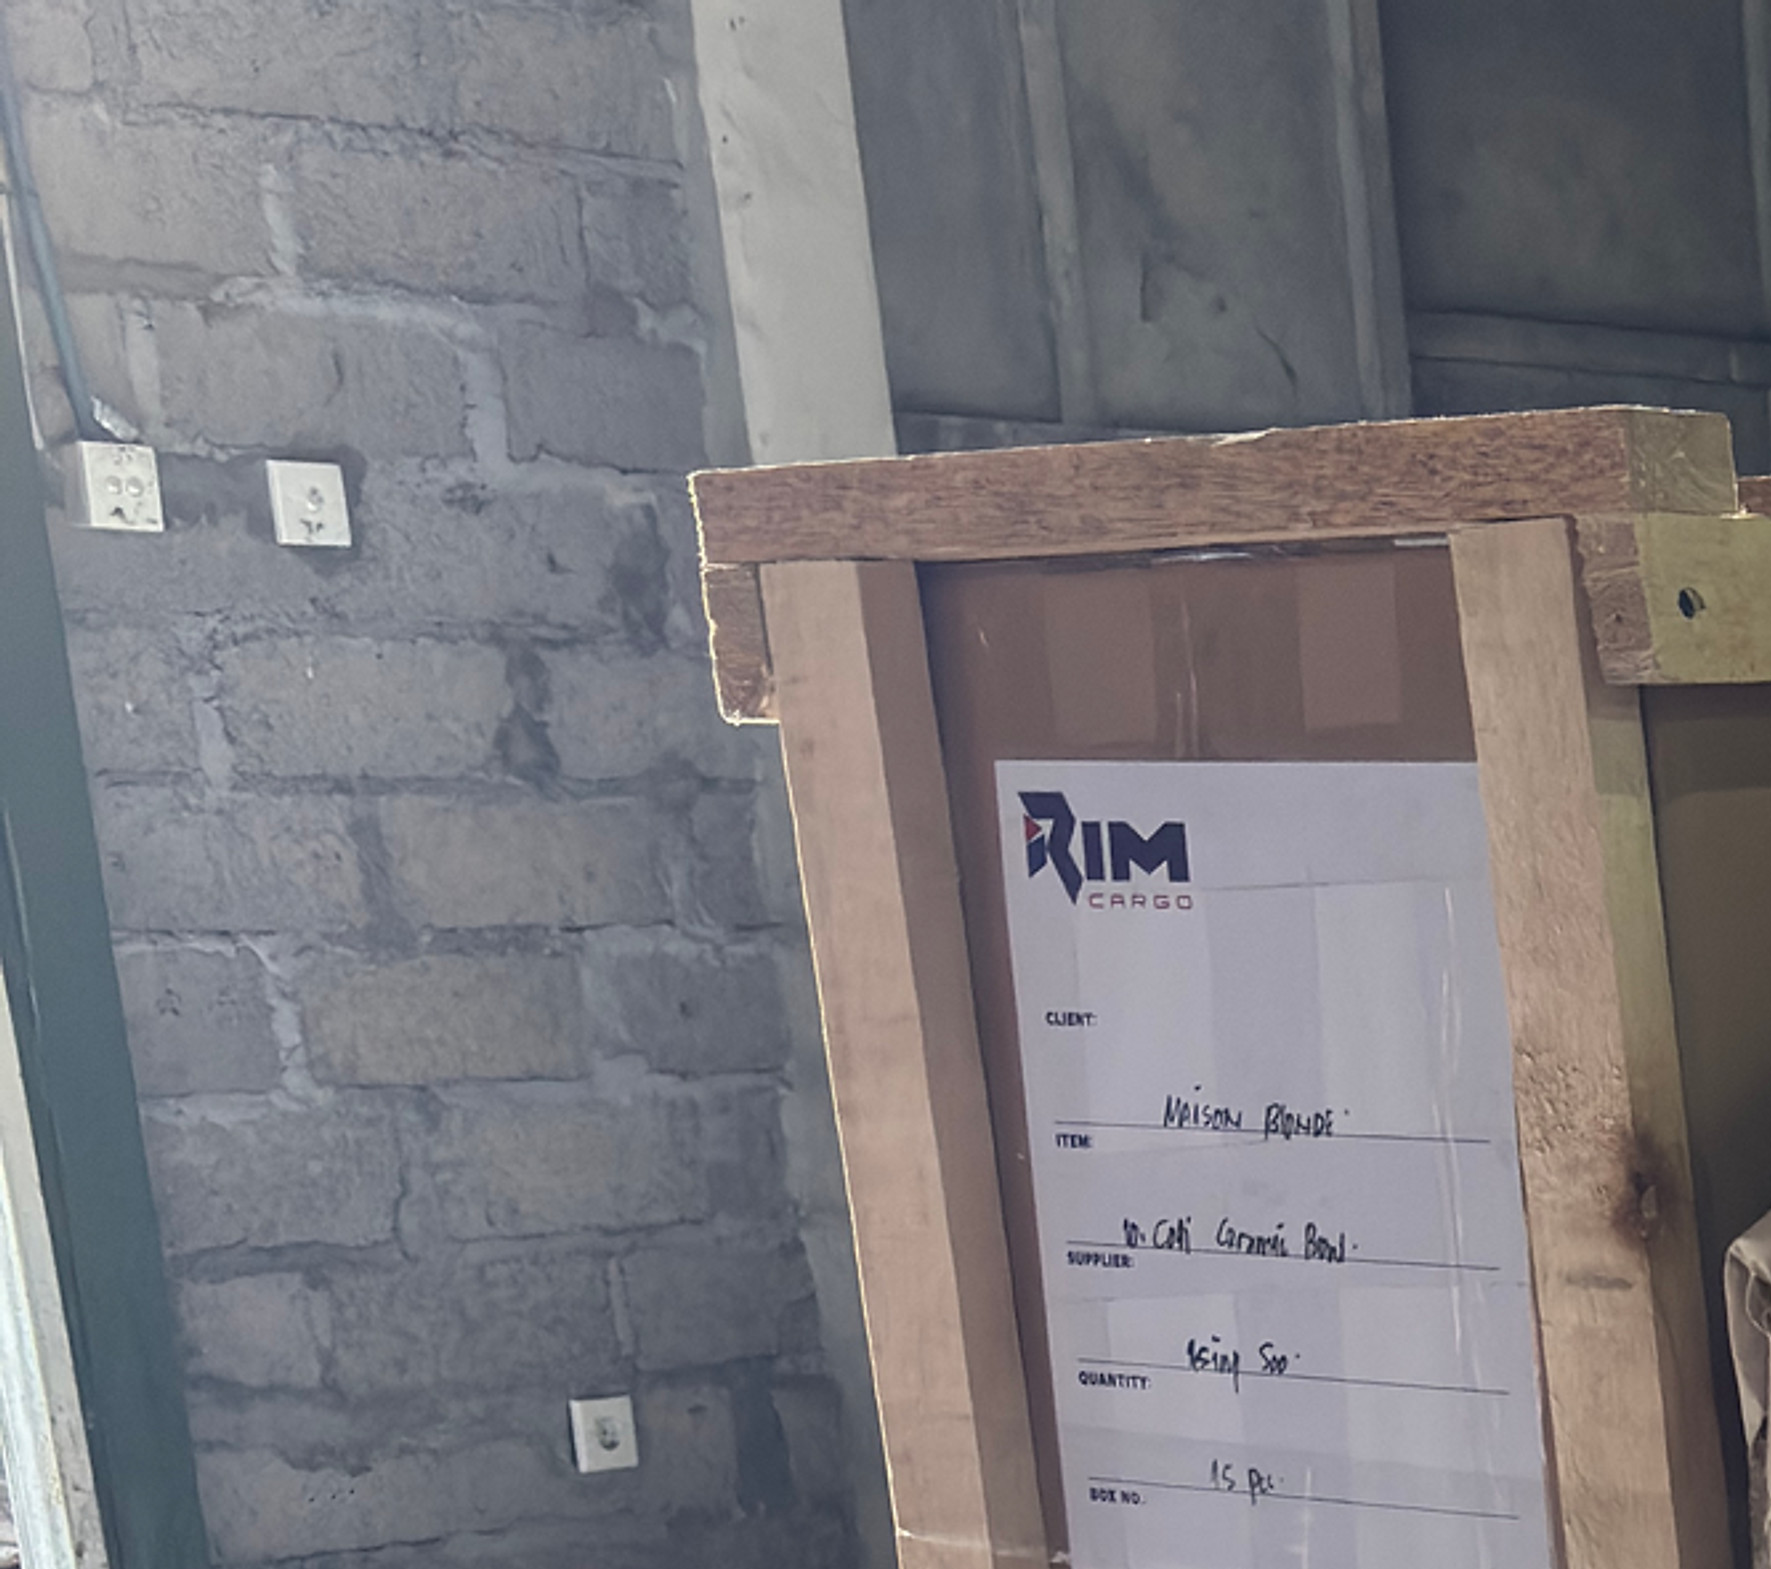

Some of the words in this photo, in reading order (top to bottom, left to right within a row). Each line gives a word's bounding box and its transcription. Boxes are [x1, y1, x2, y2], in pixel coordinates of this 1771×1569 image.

[1017, 791, 1190, 905] RIM
[1088, 893, 1193, 910] CARGO
[1045, 1011, 1097, 1028] CLIENT:
[1055, 1133, 1093, 1149] ITEM:
[1066, 1250, 1135, 1268] SUPPLIER:
[1078, 1370, 1151, 1390] QUANTITY:
[1089, 1487, 1117, 1503] BOX
